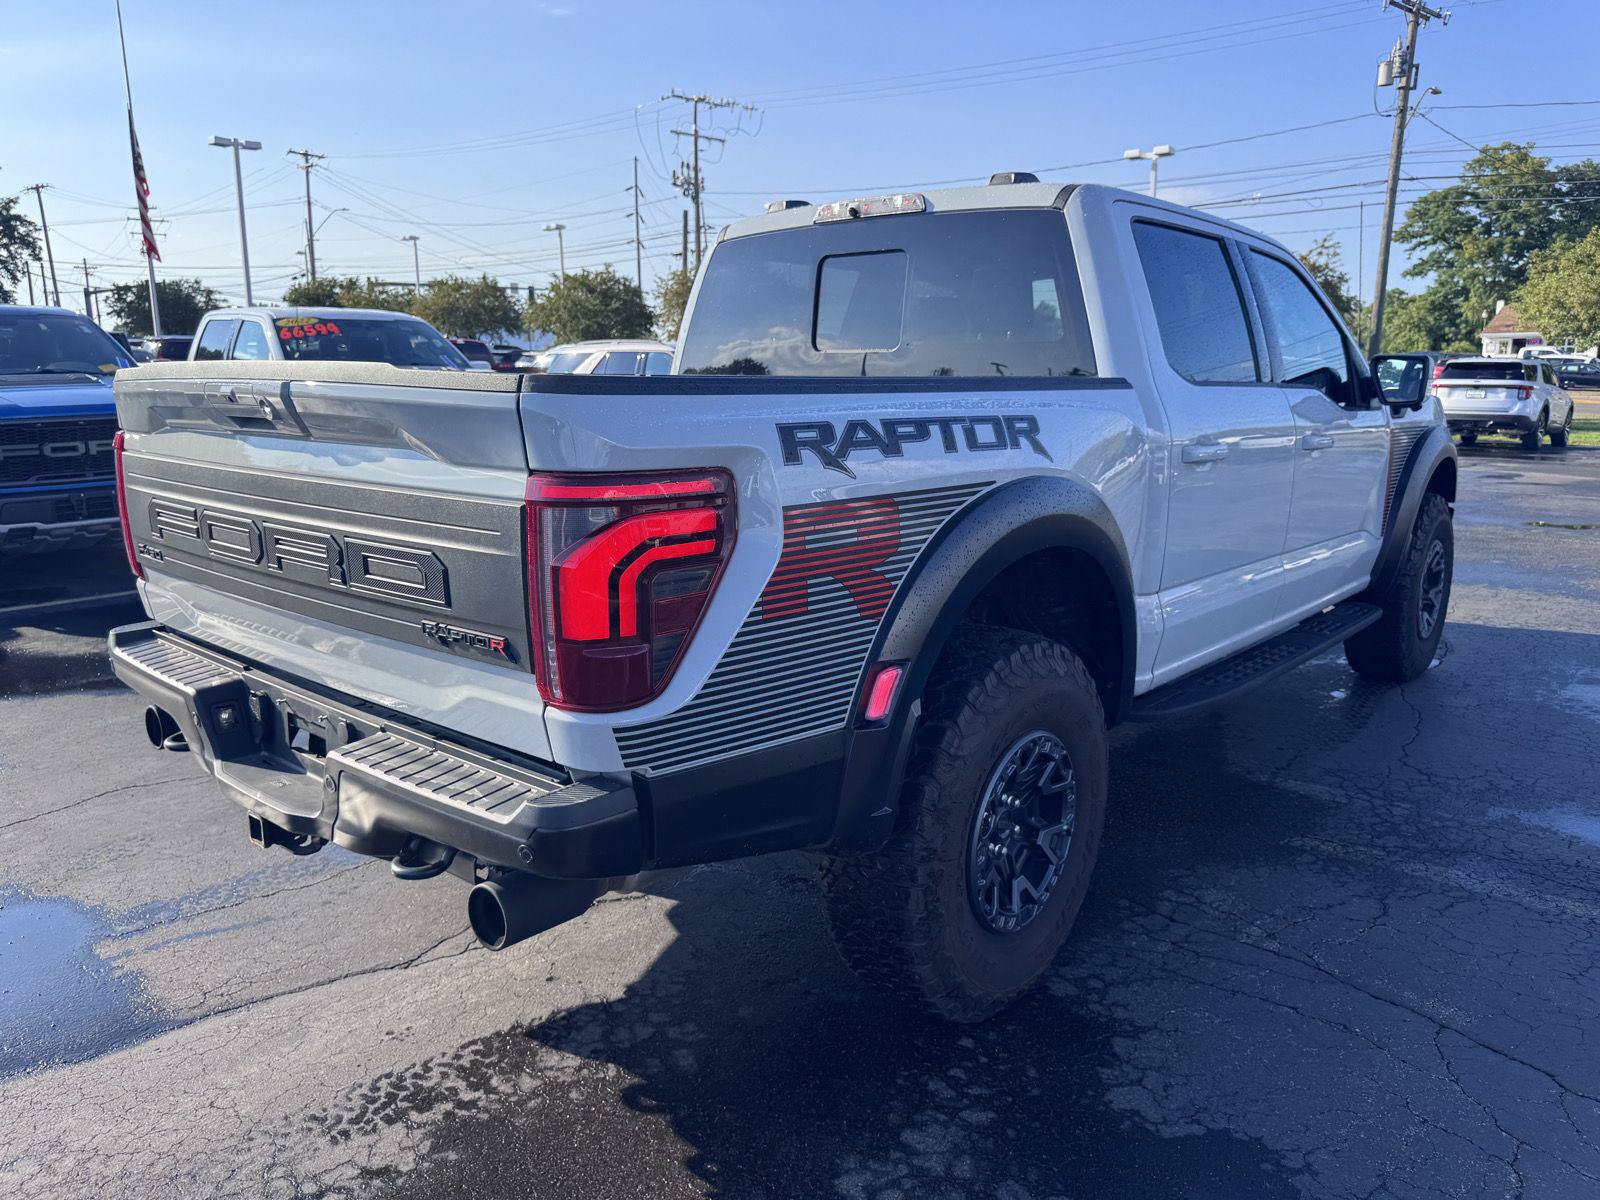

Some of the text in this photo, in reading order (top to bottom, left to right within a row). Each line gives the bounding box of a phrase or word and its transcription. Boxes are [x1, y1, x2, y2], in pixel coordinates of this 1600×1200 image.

[775, 414, 1054, 479] RAPTOR
[148, 497, 452, 610] FORD
[421, 619, 509, 661] RAPTOR
